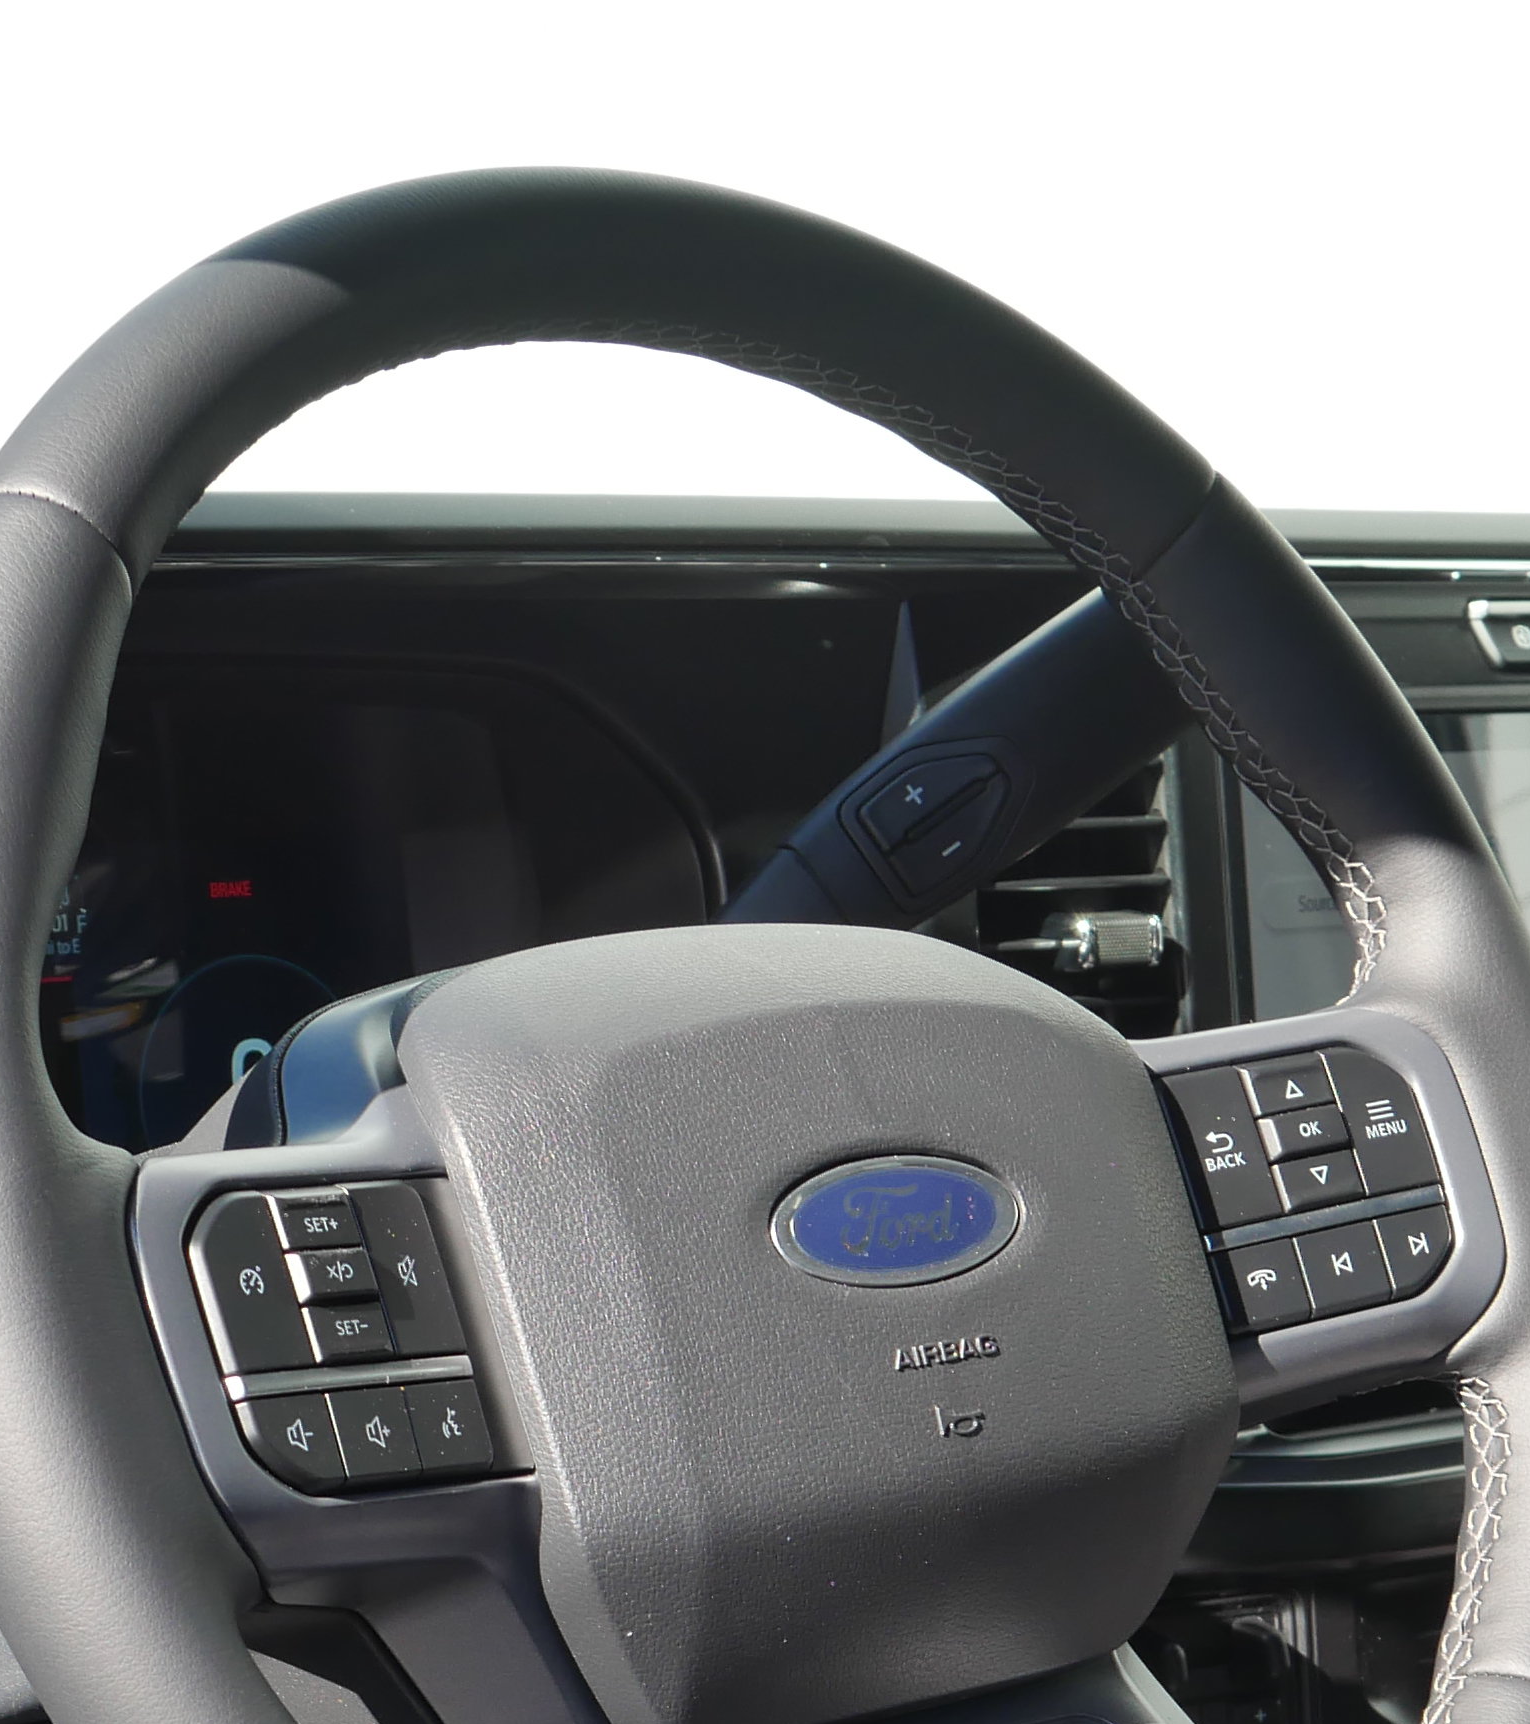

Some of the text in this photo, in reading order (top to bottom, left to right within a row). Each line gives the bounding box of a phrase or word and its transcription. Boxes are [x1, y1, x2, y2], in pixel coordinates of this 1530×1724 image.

[209, 881, 253, 898] BRAKE
[77, 914, 87, 933] F
[1298, 1121, 1323, 1138] OK
[1365, 1119, 1408, 1139] MENU
[1204, 1151, 1247, 1172] BACK
[303, 1216, 338, 1232] SET+
[840, 1184, 956, 1255] Ford
[895, 1334, 1001, 1371] AIRBAG
